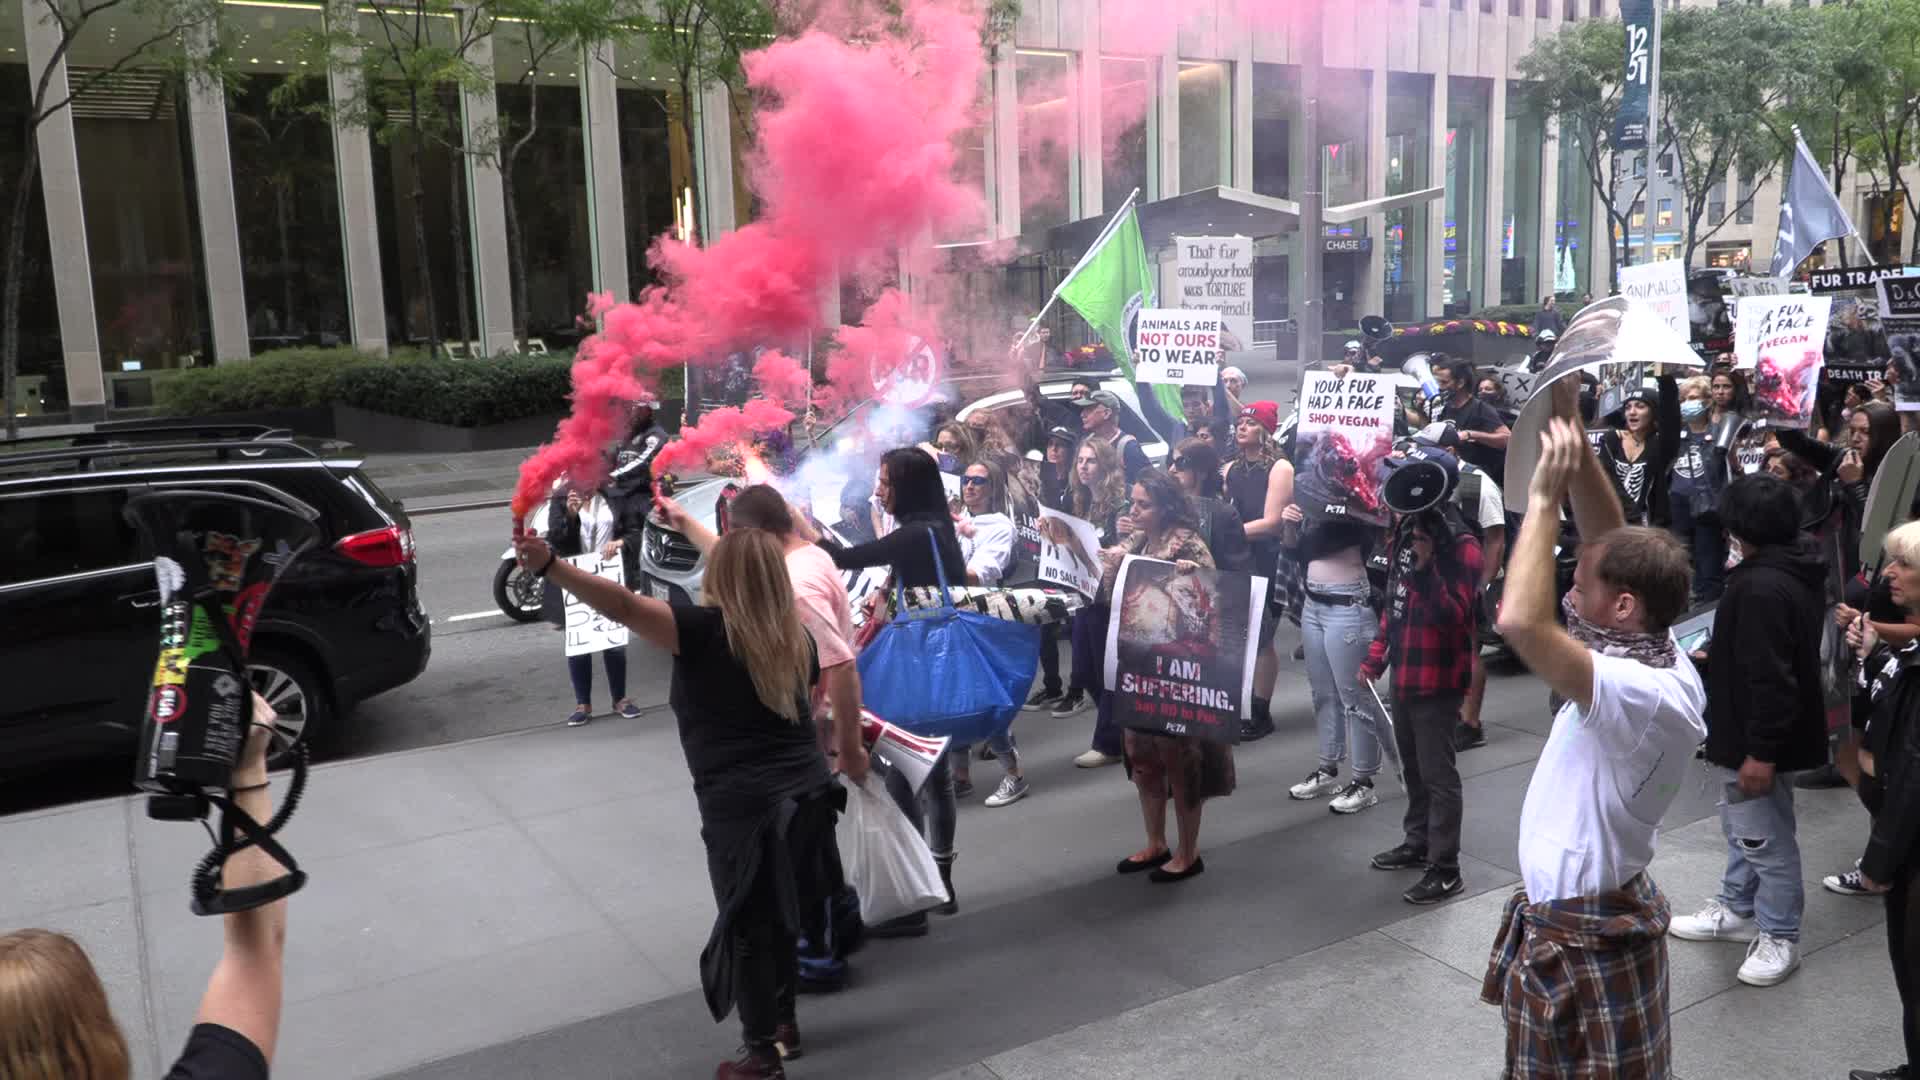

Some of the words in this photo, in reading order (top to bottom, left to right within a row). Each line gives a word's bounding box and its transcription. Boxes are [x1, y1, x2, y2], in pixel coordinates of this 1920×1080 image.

[1626, 24, 1648, 56] 12
[1626, 52, 1648, 85] 51
[1188, 244, 1215, 260] That
[1219, 243, 1240, 259] fur
[1326, 240, 1360, 251] CHASE
[1184, 285, 1203, 297] was
[1205, 281, 1246, 297] TORTURE
[1812, 274, 1842, 289] FUR
[1141, 320, 1191, 331] ANIMALS
[1194, 321, 1218, 332] ARE
[1776, 316, 1814, 333] FACE
[1140, 333, 1169, 346] NOT
[1174, 334, 1216, 348] OURS
[1766, 335, 1808, 349] VEGAN
[1140, 348, 1160, 363] TO
[1165, 349, 1216, 365] WEAR
[1828, 369, 1864, 380] DEATH
[1314, 379, 1345, 394] YOUR
[1348, 380, 1377, 393] FUR
[1308, 395, 1333, 409] HAD
[1334, 397, 1343, 409] A
[1348, 395, 1384, 409] FACE
[1309, 413, 1336, 425] SHOP
[1338, 415, 1379, 427] VEGAN
[1046, 567, 1058, 580] NO
[1156, 656, 1163, 674] I
[1169, 659, 1201, 681] AM
[1121, 672, 1235, 711] SUFFERING.
